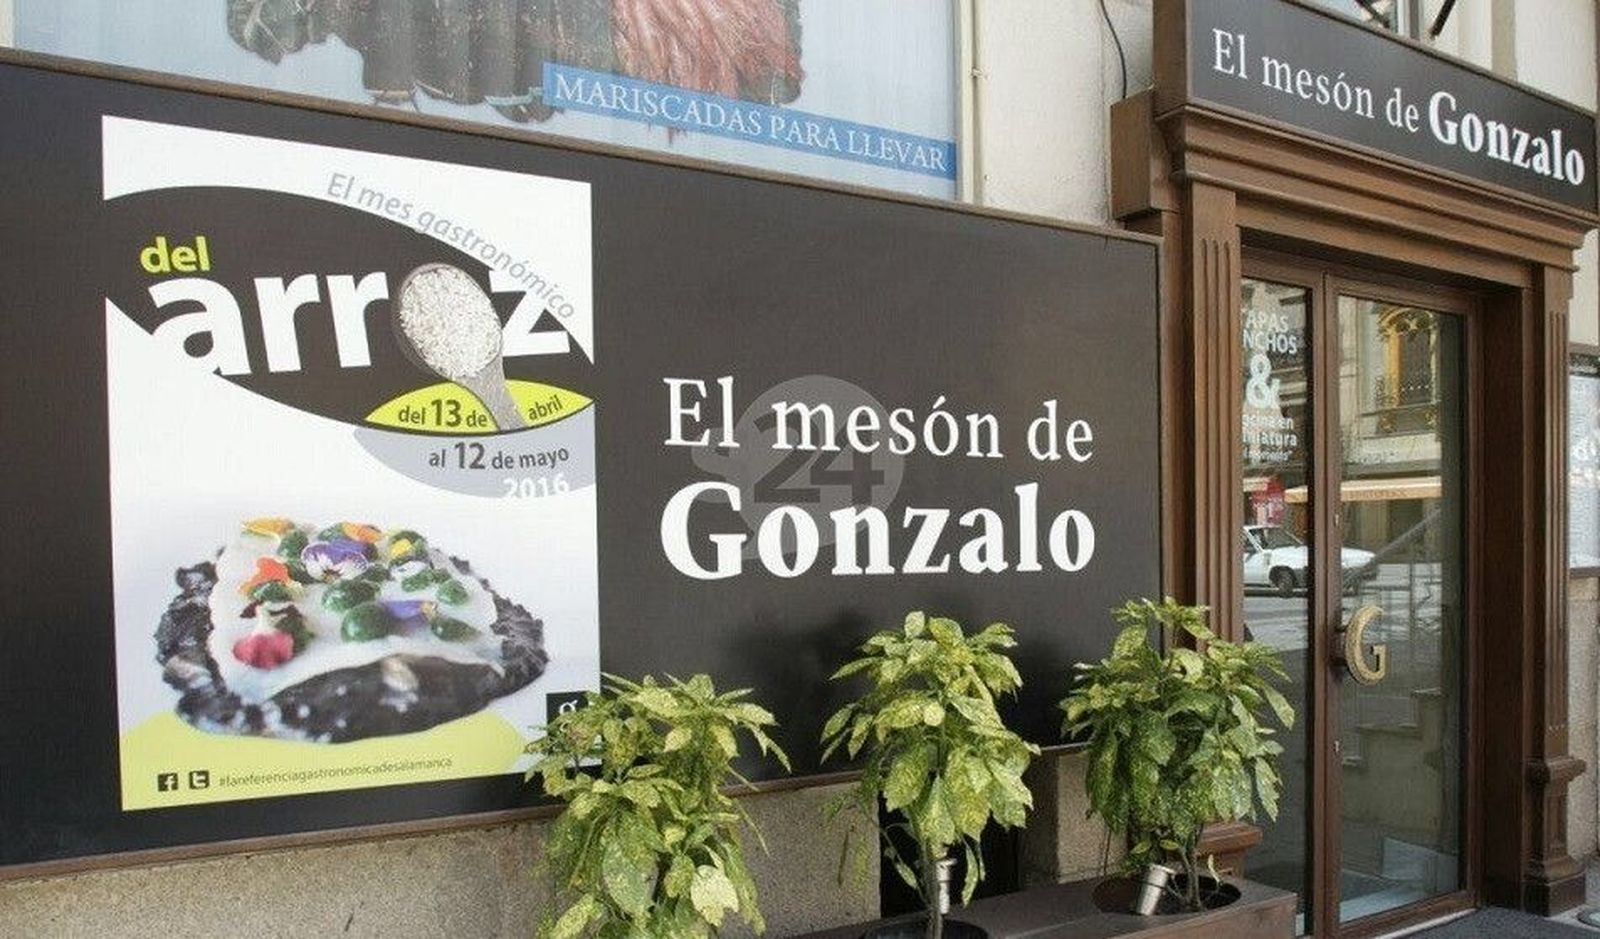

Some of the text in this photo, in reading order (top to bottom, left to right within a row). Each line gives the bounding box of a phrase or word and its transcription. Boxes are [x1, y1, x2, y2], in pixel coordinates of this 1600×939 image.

[554, 73, 948, 173] MARISCADAS PARA LLEVAR
[1212, 28, 1585, 186] El mesón de Gonzalo
[140, 235, 212, 274] del
[327, 172, 575, 319] El mes gastronómico
[398, 394, 563, 428] del 13 de abril
[663, 375, 1094, 463] El mesón de
[429, 442, 569, 470] al 12 de mayo
[503, 472, 570, 499] 2016
[660, 480, 1095, 580] Gonzalo
[1344, 605, 1387, 686] G
